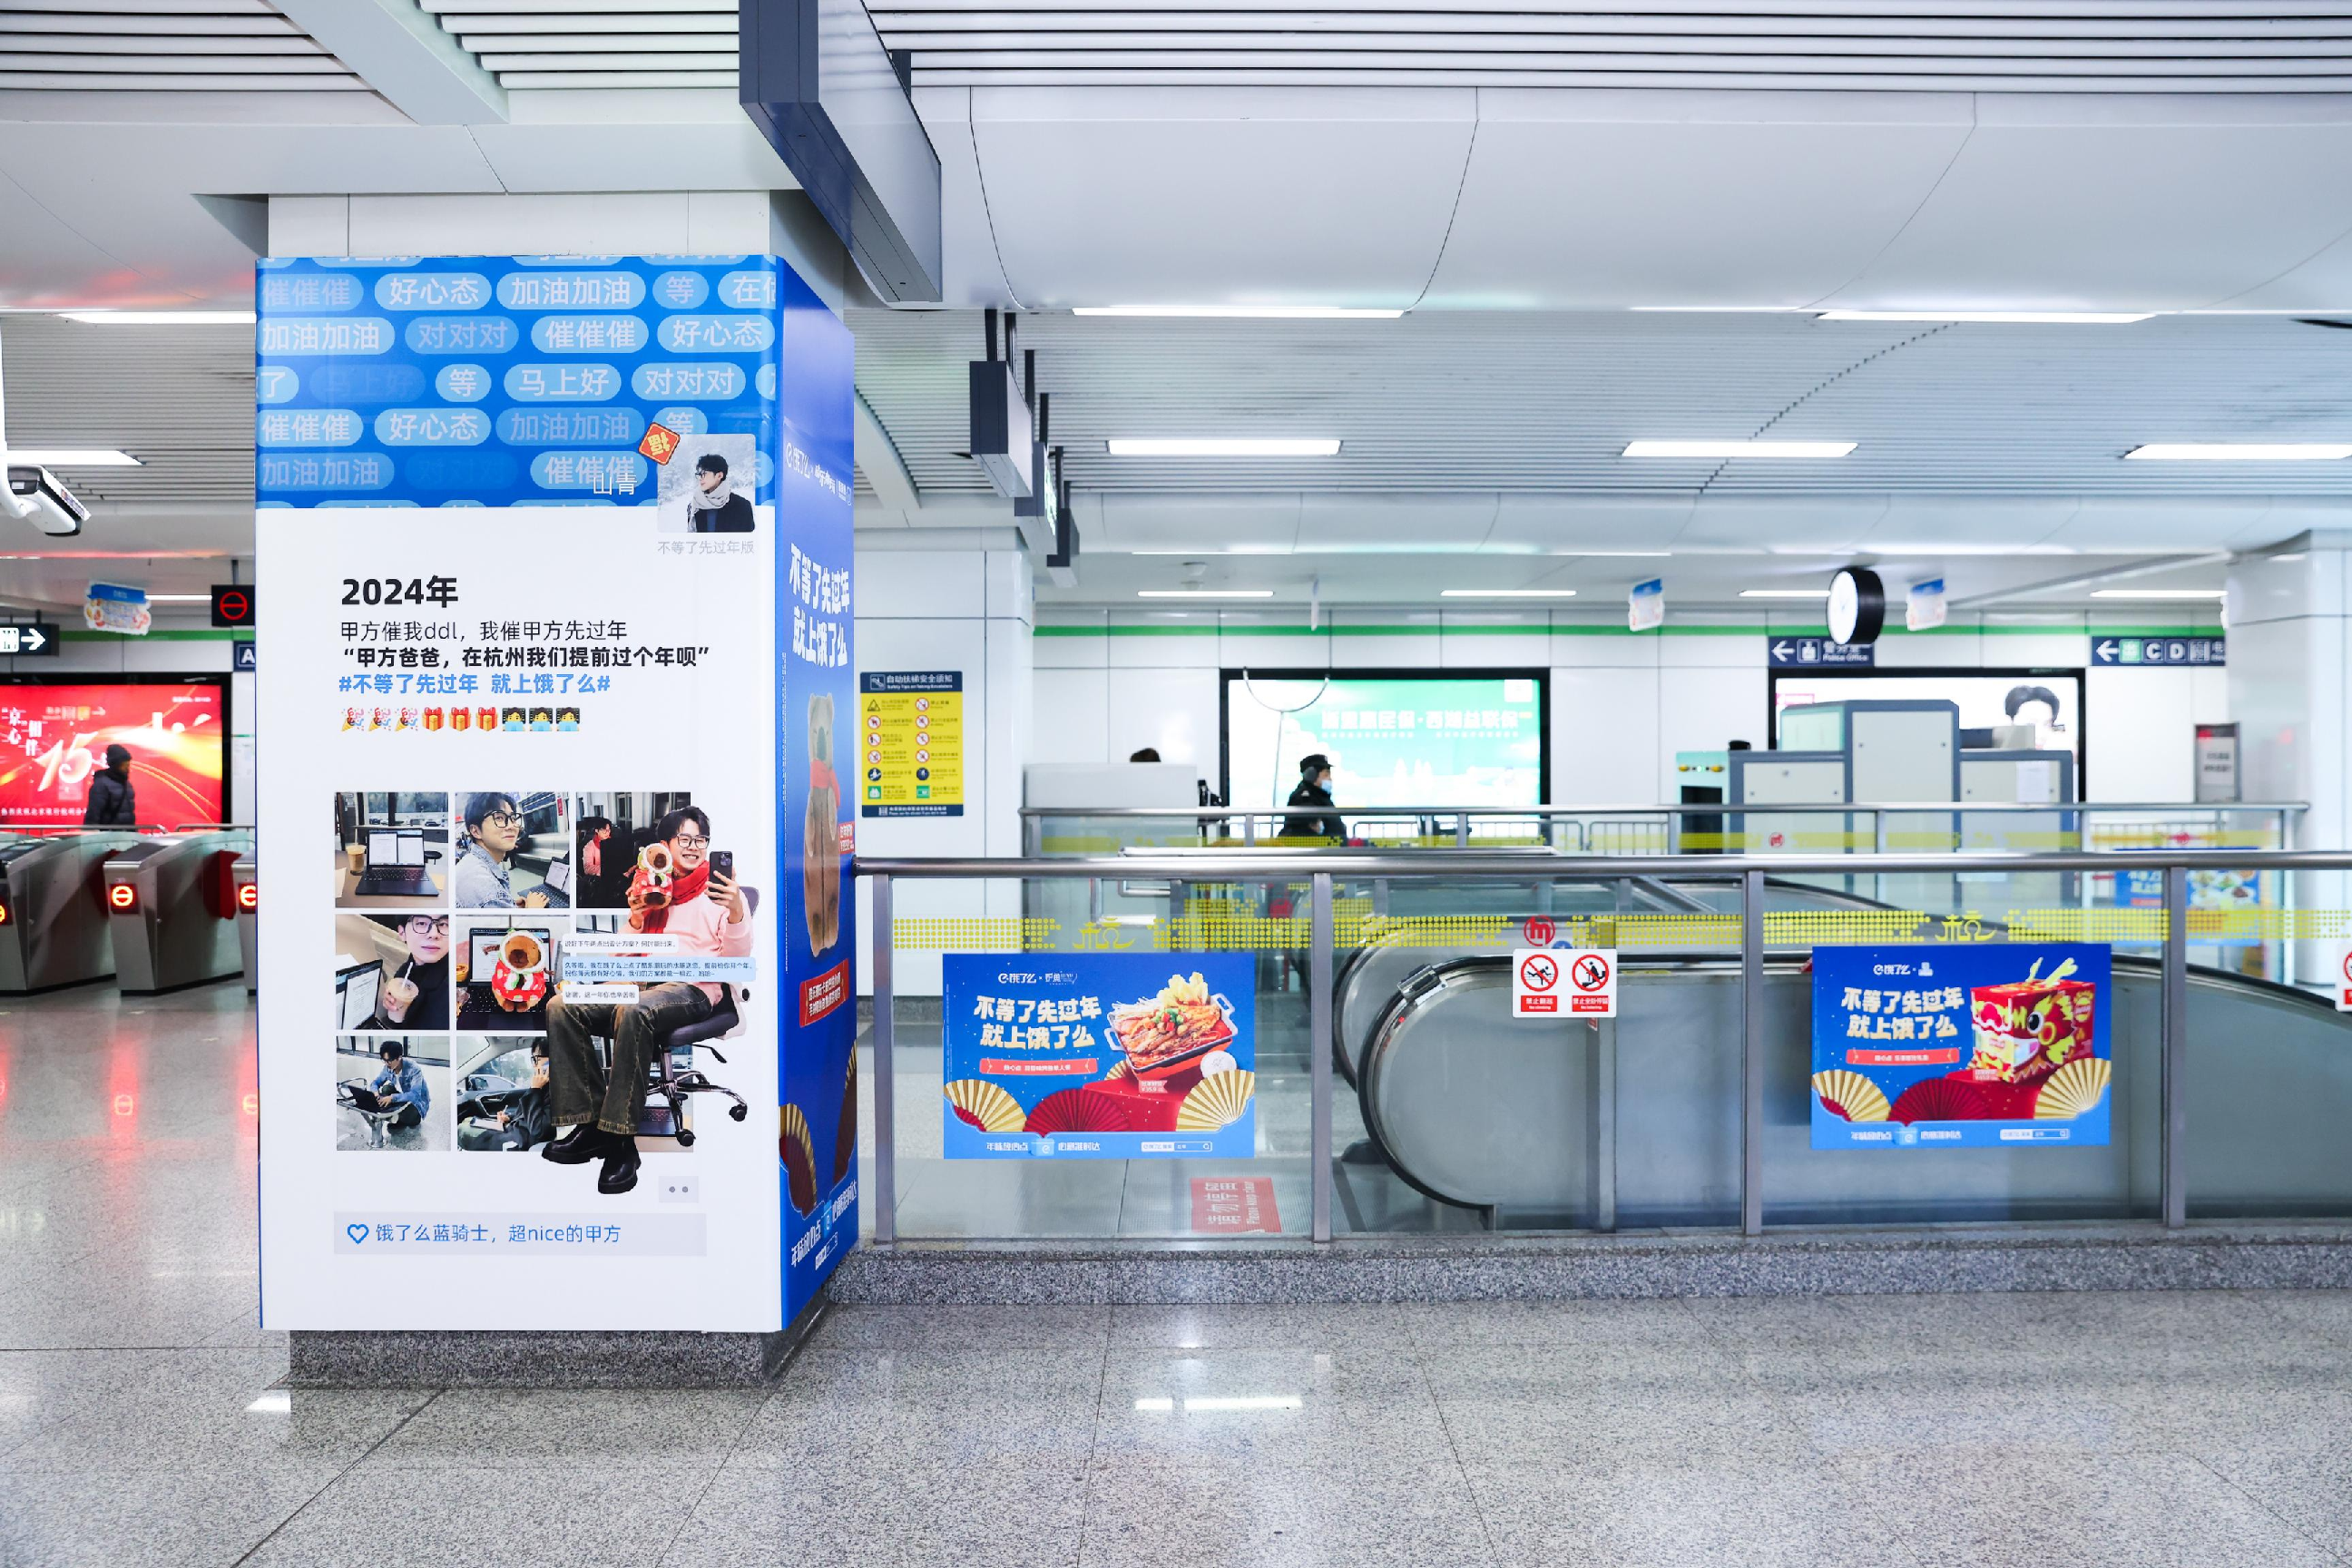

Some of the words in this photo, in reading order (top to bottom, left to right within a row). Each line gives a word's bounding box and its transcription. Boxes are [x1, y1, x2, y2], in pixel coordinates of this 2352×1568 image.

[262, 278, 351, 307] 催催催
[388, 277, 479, 306] 好心态
[510, 277, 631, 305] 加油加油
[665, 276, 694, 304] 等
[262, 322, 380, 351] 加油加油
[417, 321, 508, 348] 对对对
[544, 320, 636, 348] 催催催
[672, 319, 763, 348] 好心态
[256, 370, 287, 398] 了
[448, 368, 477, 397] 等
[518, 368, 610, 397] 马上好
[644, 368, 735, 396] 对对对
[261, 413, 351, 442] 催催催
[388, 413, 479, 441] 好心态
[510, 412, 631, 441] 加油加油
[262, 457, 379, 486] 加油加油
[544, 456, 635, 485] 催催催
[592, 472, 638, 496] 山青
[657, 540, 755, 555] 不等了先过年版
[341, 575, 459, 608] 2024年
[789, 543, 850, 615] 不等了先过年
[340, 620, 628, 642] 甲方催我ddl，我催甲方先过年
[791, 605, 848, 668] 就上饿了么
[241, 649, 256, 664] A
[2146, 642, 2161, 660] C
[2170, 642, 2185, 659] D
[338, 673, 479, 694] #不等了先过年
[491, 673, 611, 694] 就上饿了么#
[973, 995, 1102, 1024] 不等了先过年
[1840, 986, 1965, 1014] 不等了先过年
[979, 1023, 1096, 1051] 就上饿了么
[1847, 1014, 1958, 1041] 就上饿了么
[375, 1223, 622, 1245] 饿了么蓝骑士，超nice的甲方
